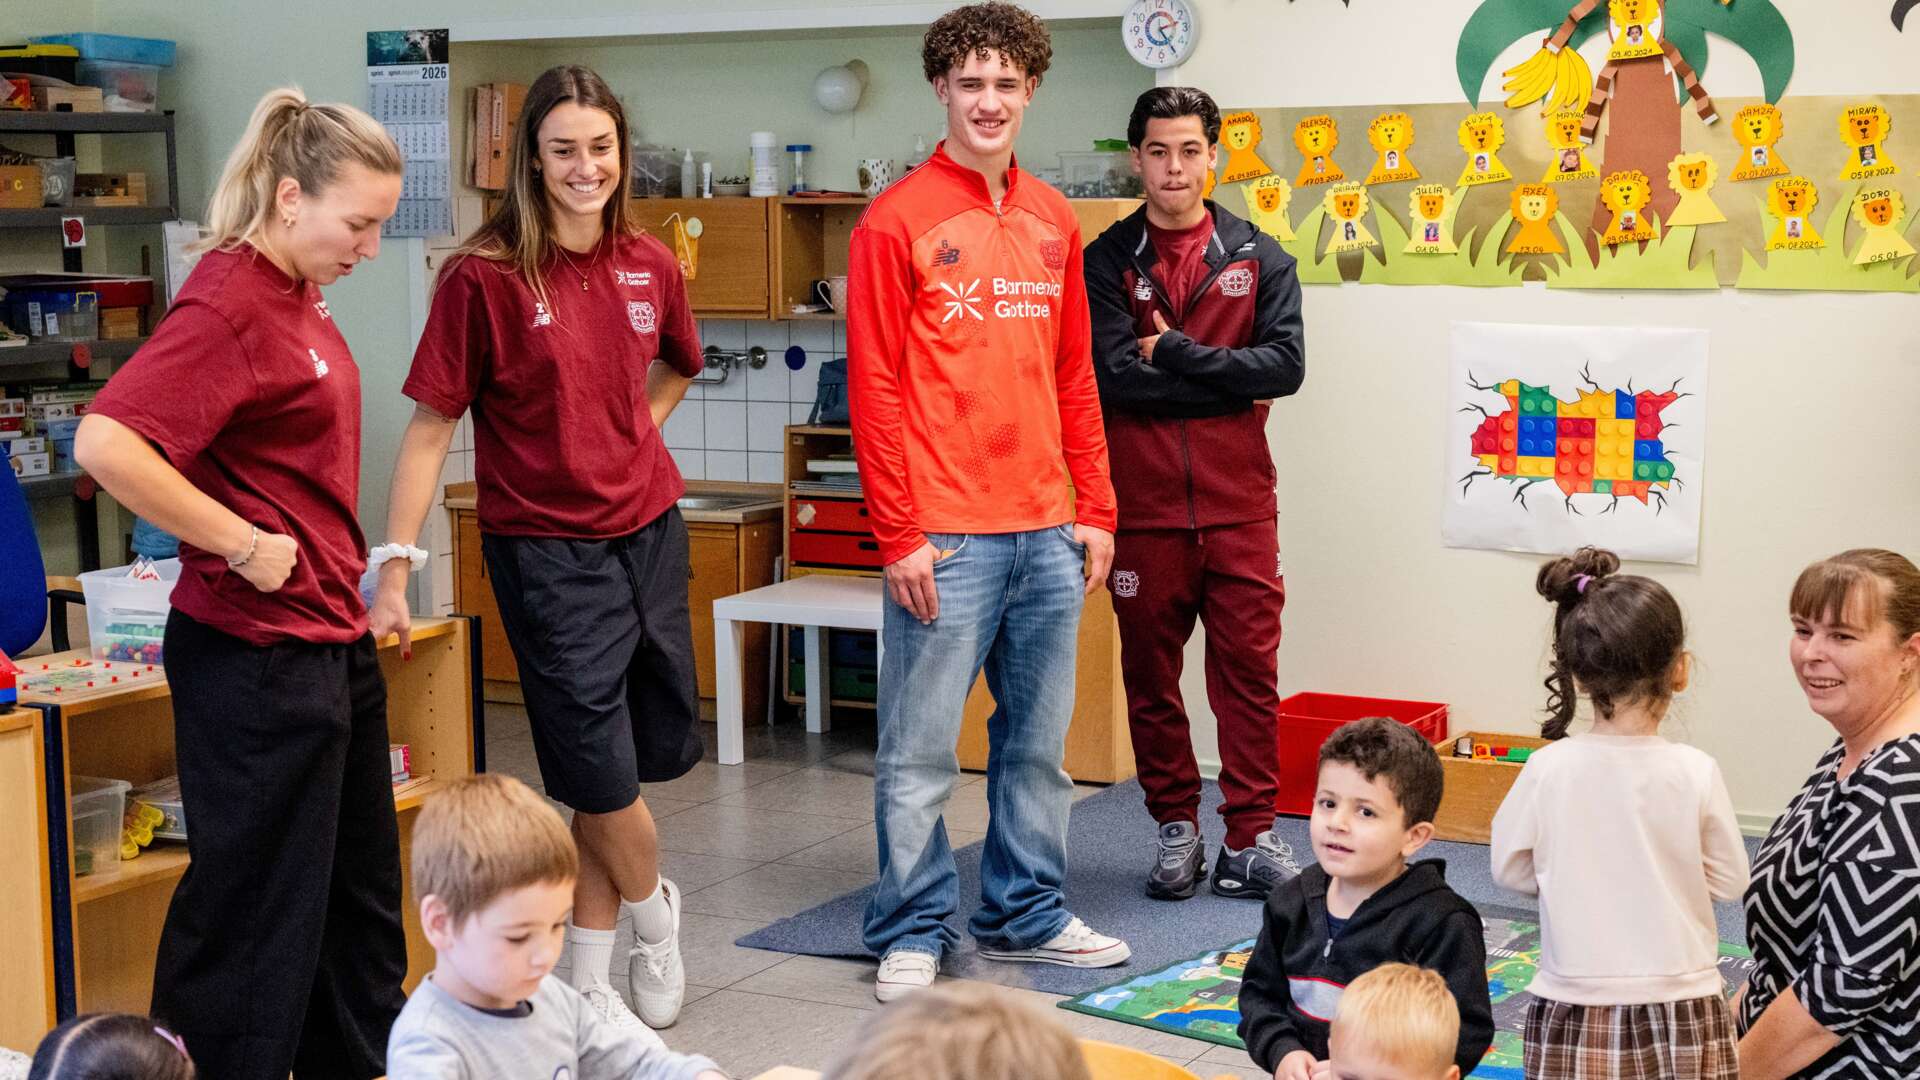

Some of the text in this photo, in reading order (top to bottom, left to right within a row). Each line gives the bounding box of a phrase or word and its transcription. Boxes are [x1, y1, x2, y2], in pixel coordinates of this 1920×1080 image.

[422, 67, 447, 79] 2026
[1738, 107, 1774, 119] HAMZA
[1848, 106, 1878, 117] MIRNA
[1260, 178, 1281, 187] ELA
[1607, 173, 1643, 185] DANIEL
[1775, 180, 1809, 188] ELENA
[1415, 187, 1443, 196] JULIA
[1522, 187, 1548, 196] AXEL
[1862, 190, 1890, 201] DORO
[993, 278, 1061, 296] Barmenia
[995, 301, 1050, 318] Gothae
